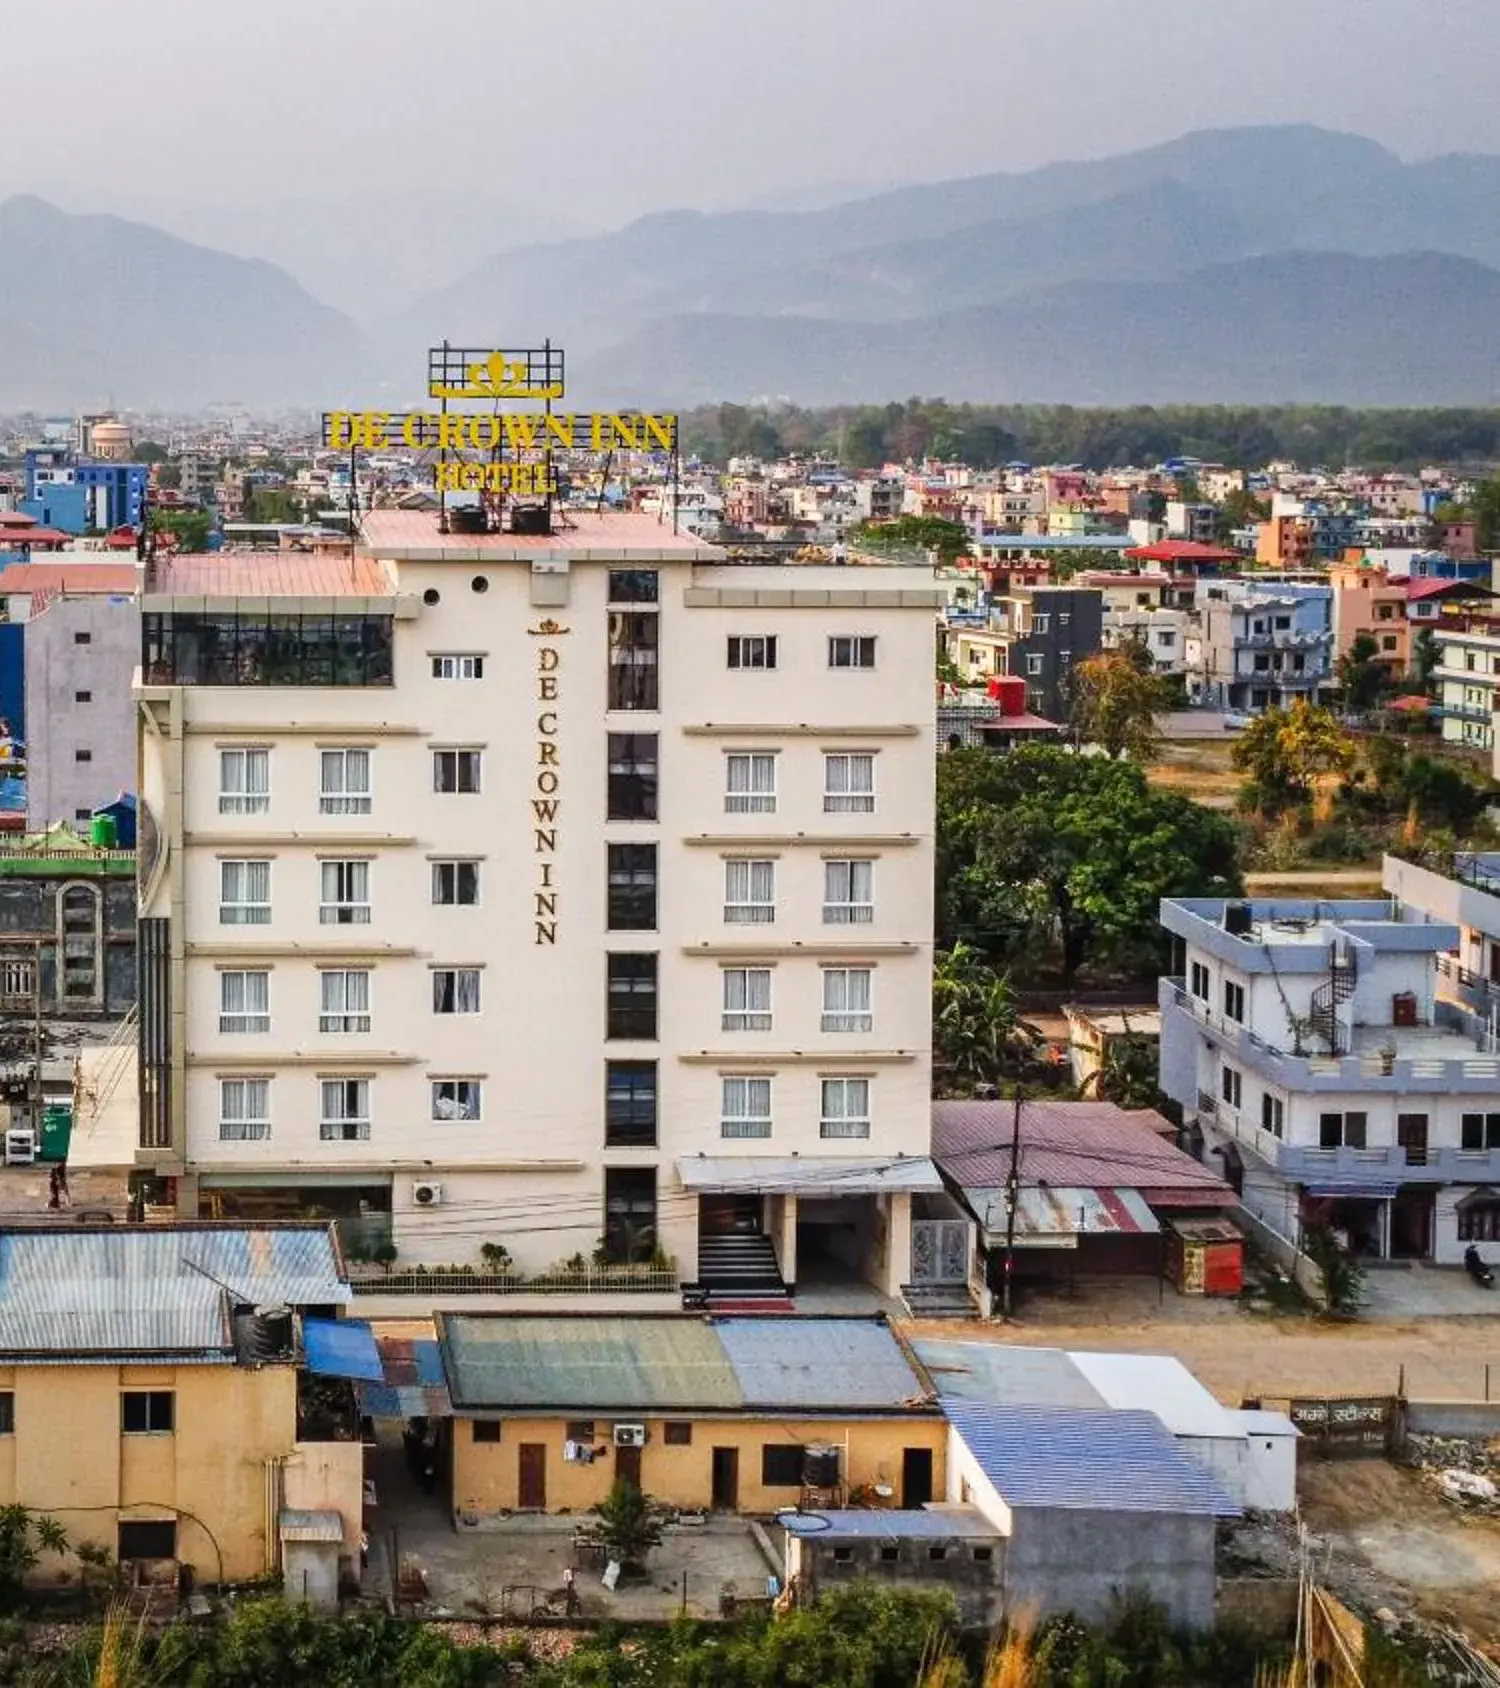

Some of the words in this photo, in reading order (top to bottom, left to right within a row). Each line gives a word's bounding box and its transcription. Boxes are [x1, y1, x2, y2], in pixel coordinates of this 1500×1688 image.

[328, 411, 390, 450] DE
[403, 412, 576, 451] CROWN
[588, 414, 677, 452] INN
[435, 461, 557, 494] HOTEL
[537, 647, 559, 701] DE
[531, 713, 560, 852] CROWN
[534, 863, 559, 945] INN
